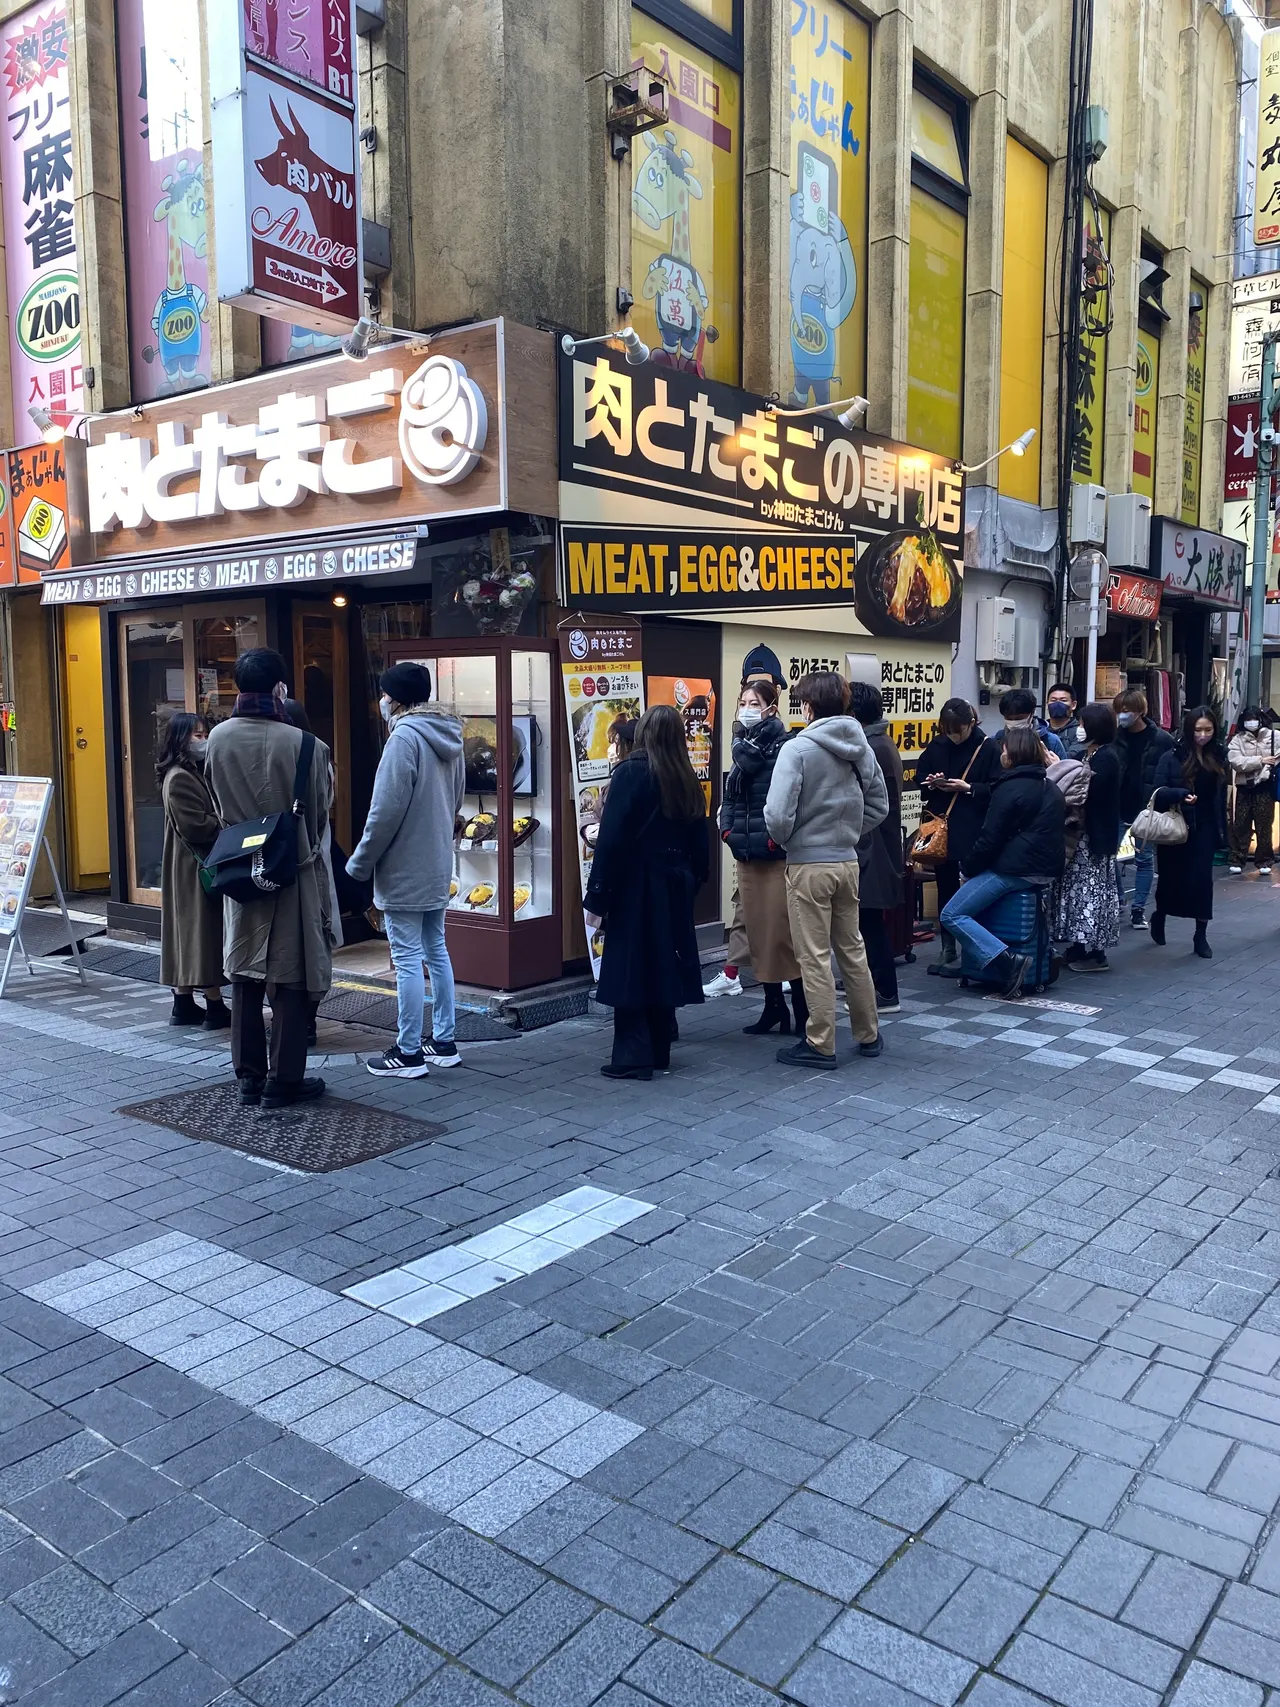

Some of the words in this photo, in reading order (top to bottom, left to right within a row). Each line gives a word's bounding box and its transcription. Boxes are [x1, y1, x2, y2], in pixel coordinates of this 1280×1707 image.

[328, 65, 349, 97] B1
[658, 48, 719, 115] 入園口
[8, 91, 70, 141] フリー
[22, 129, 77, 270] 麻雀
[286, 158, 353, 209] 肉バル
[251, 206, 357, 269] Amore
[38, 285, 67, 301] MAHJONG
[28, 293, 81, 342] ZOO
[167, 315, 193, 335] ZOO
[40, 334, 69, 350] SHINJUKU
[28, 364, 84, 403] 入園口
[87, 368, 402, 532] 肉とたまご
[573, 358, 962, 535] 肉とたまごの専門店
[11, 450, 66, 498] まぁじゃん
[33, 508, 49, 535] ZOO
[761, 499, 844, 532] by神田たまごけん
[43, 580, 80, 602] MEAT
[95, 575, 121, 598] EGG
[141, 567, 195, 594] CHEESE
[215, 559, 259, 587] MEAT
[283, 552, 316, 580] EGG
[342, 541, 415, 573] CHEESE
[1183, 537, 1242, 605] 大勝軒
[881, 661, 944, 684] 肉とたまごの
[682, 708, 707, 716] ス専門店
[881, 687, 934, 713] 専門店は
[695, 765, 709, 779] EN
